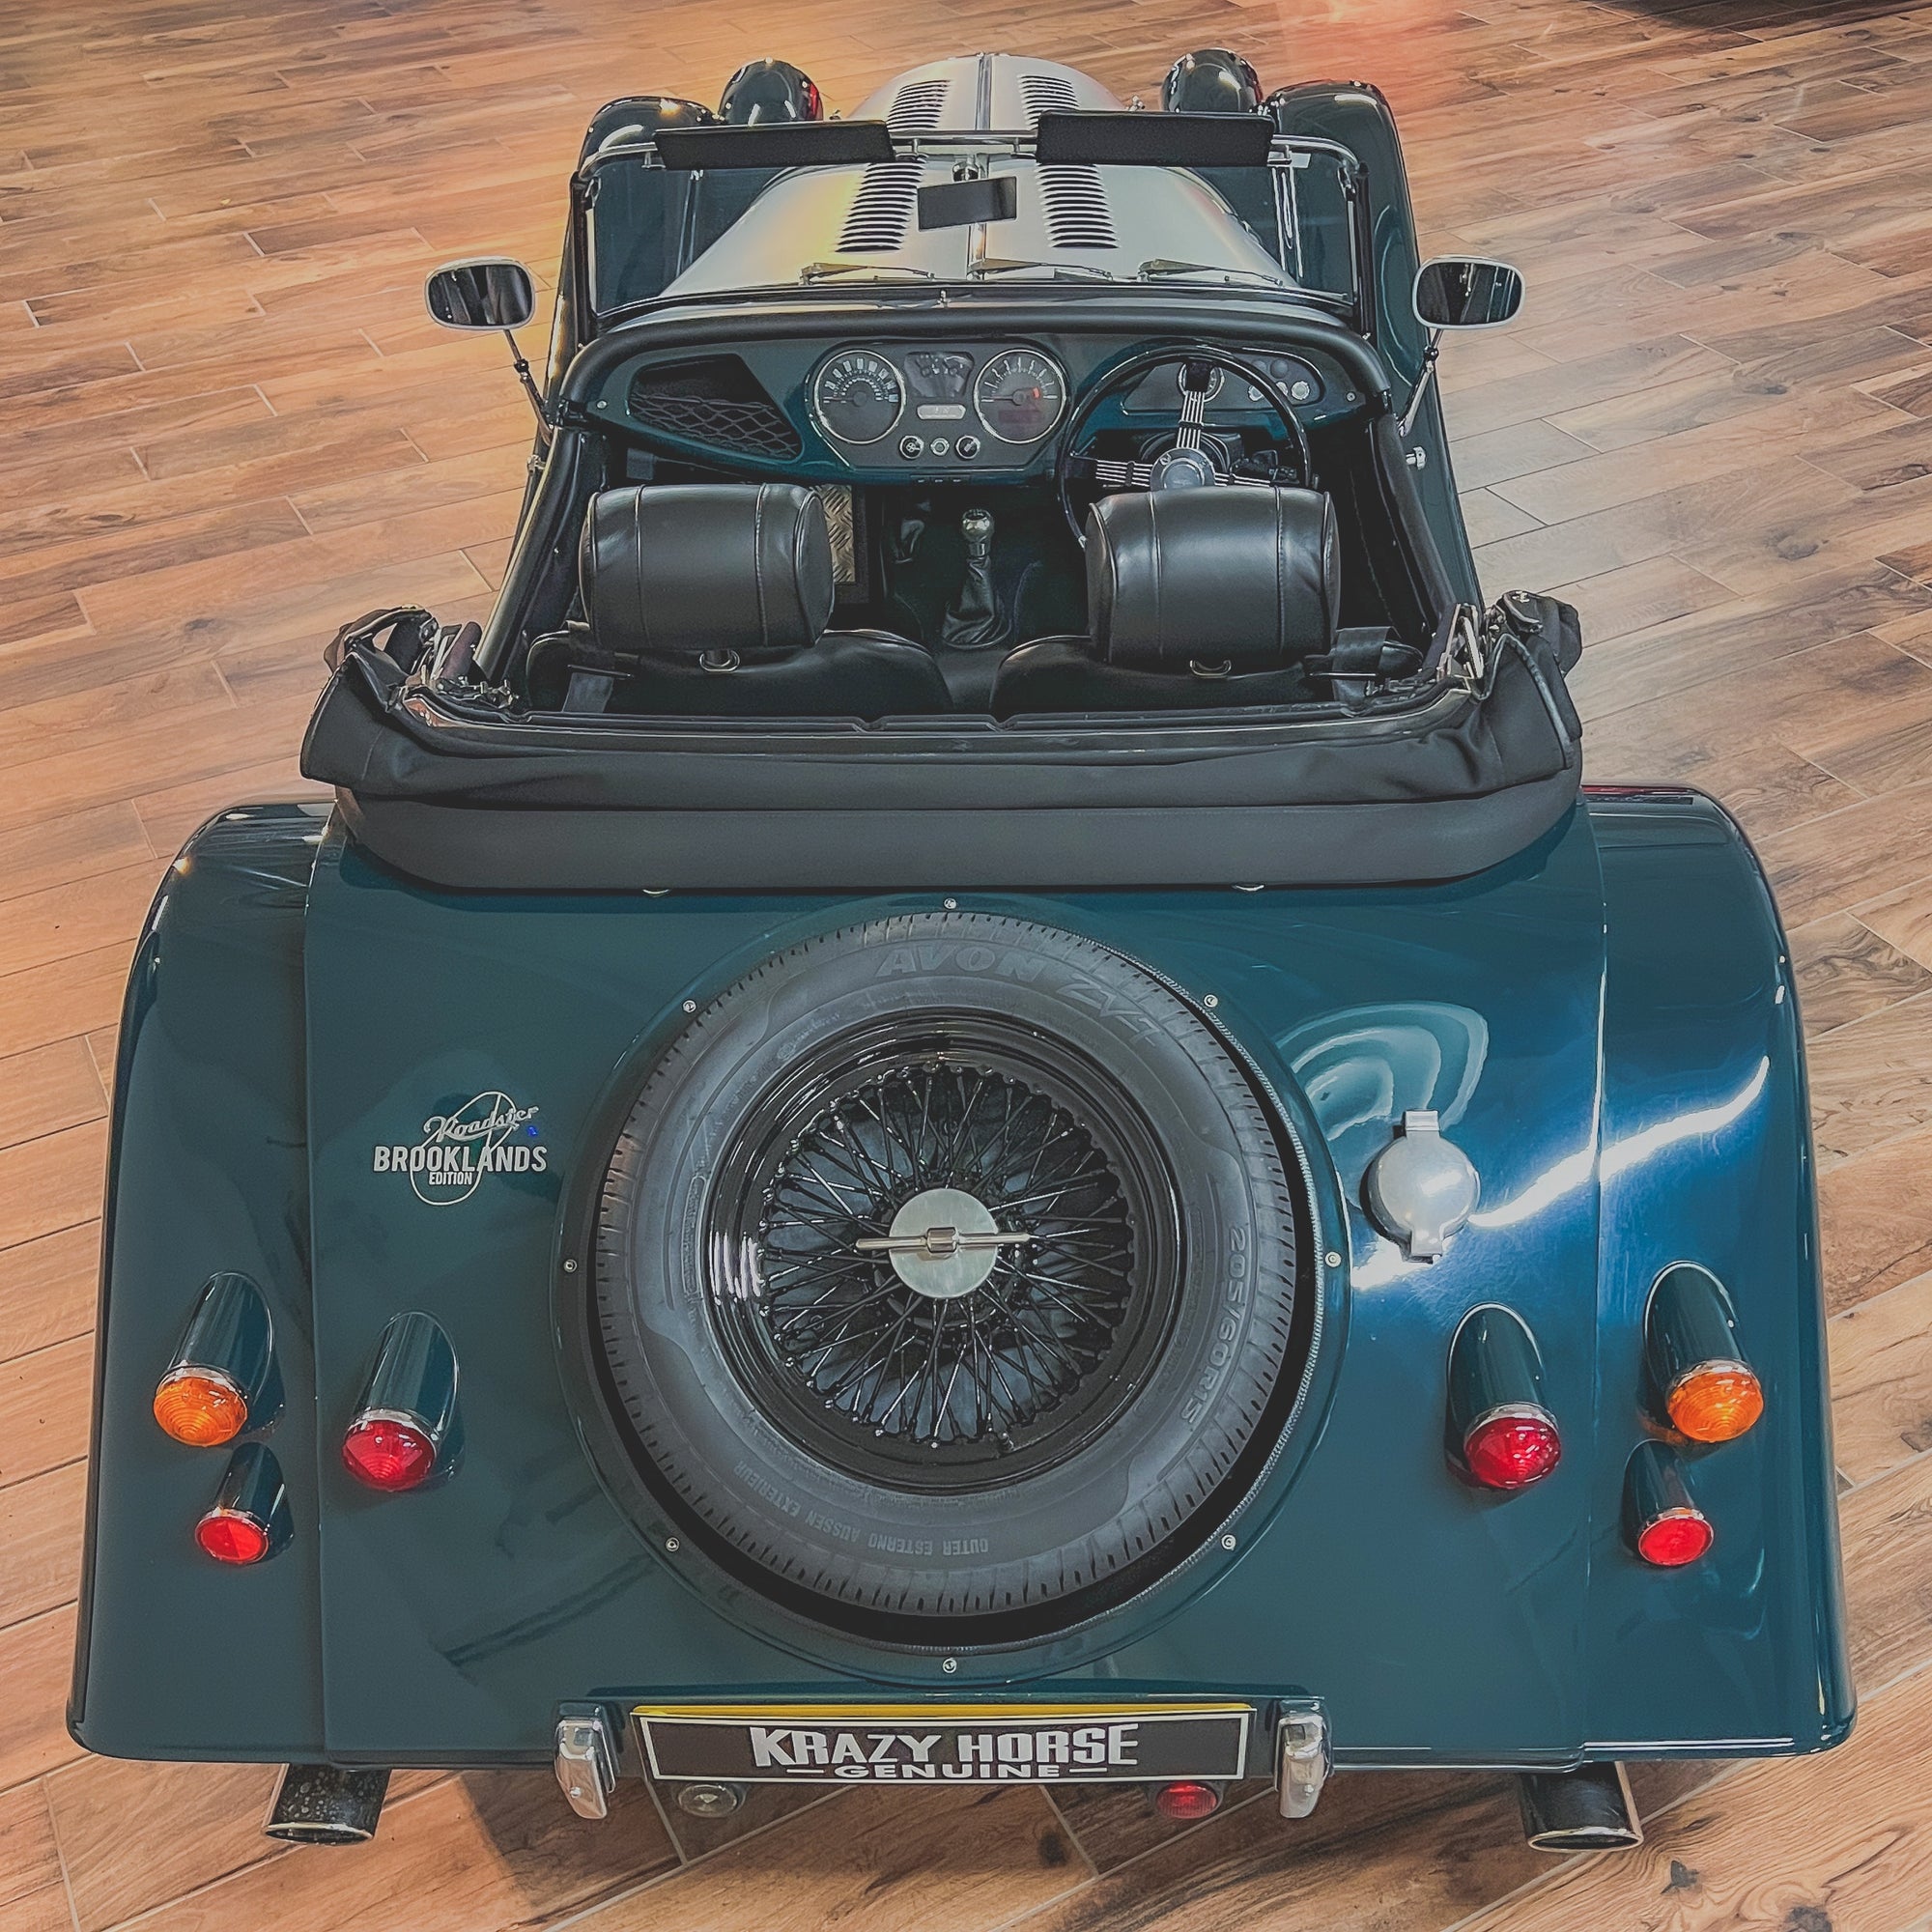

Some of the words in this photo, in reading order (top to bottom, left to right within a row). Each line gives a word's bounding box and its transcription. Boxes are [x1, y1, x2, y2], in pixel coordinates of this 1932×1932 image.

[874, 944, 1046, 982] AVON
[423, 1106, 539, 1143] Roadster
[373, 1146, 548, 1173] BROOKLANDS
[428, 1171, 473, 1185] EDITION
[1180, 1226, 1247, 1425] 205/60R15
[732, 1460, 803, 1519] EXTERIEUR
[803, 1509, 862, 1544] AUSSEN
[868, 1532, 933, 1556] ESTERNO
[942, 1538, 989, 1556] OUTER
[750, 1726, 942, 1767] KRAZY
[958, 1723, 1139, 1766] HORSE
[834, 1764, 1061, 1778] GENUINE
